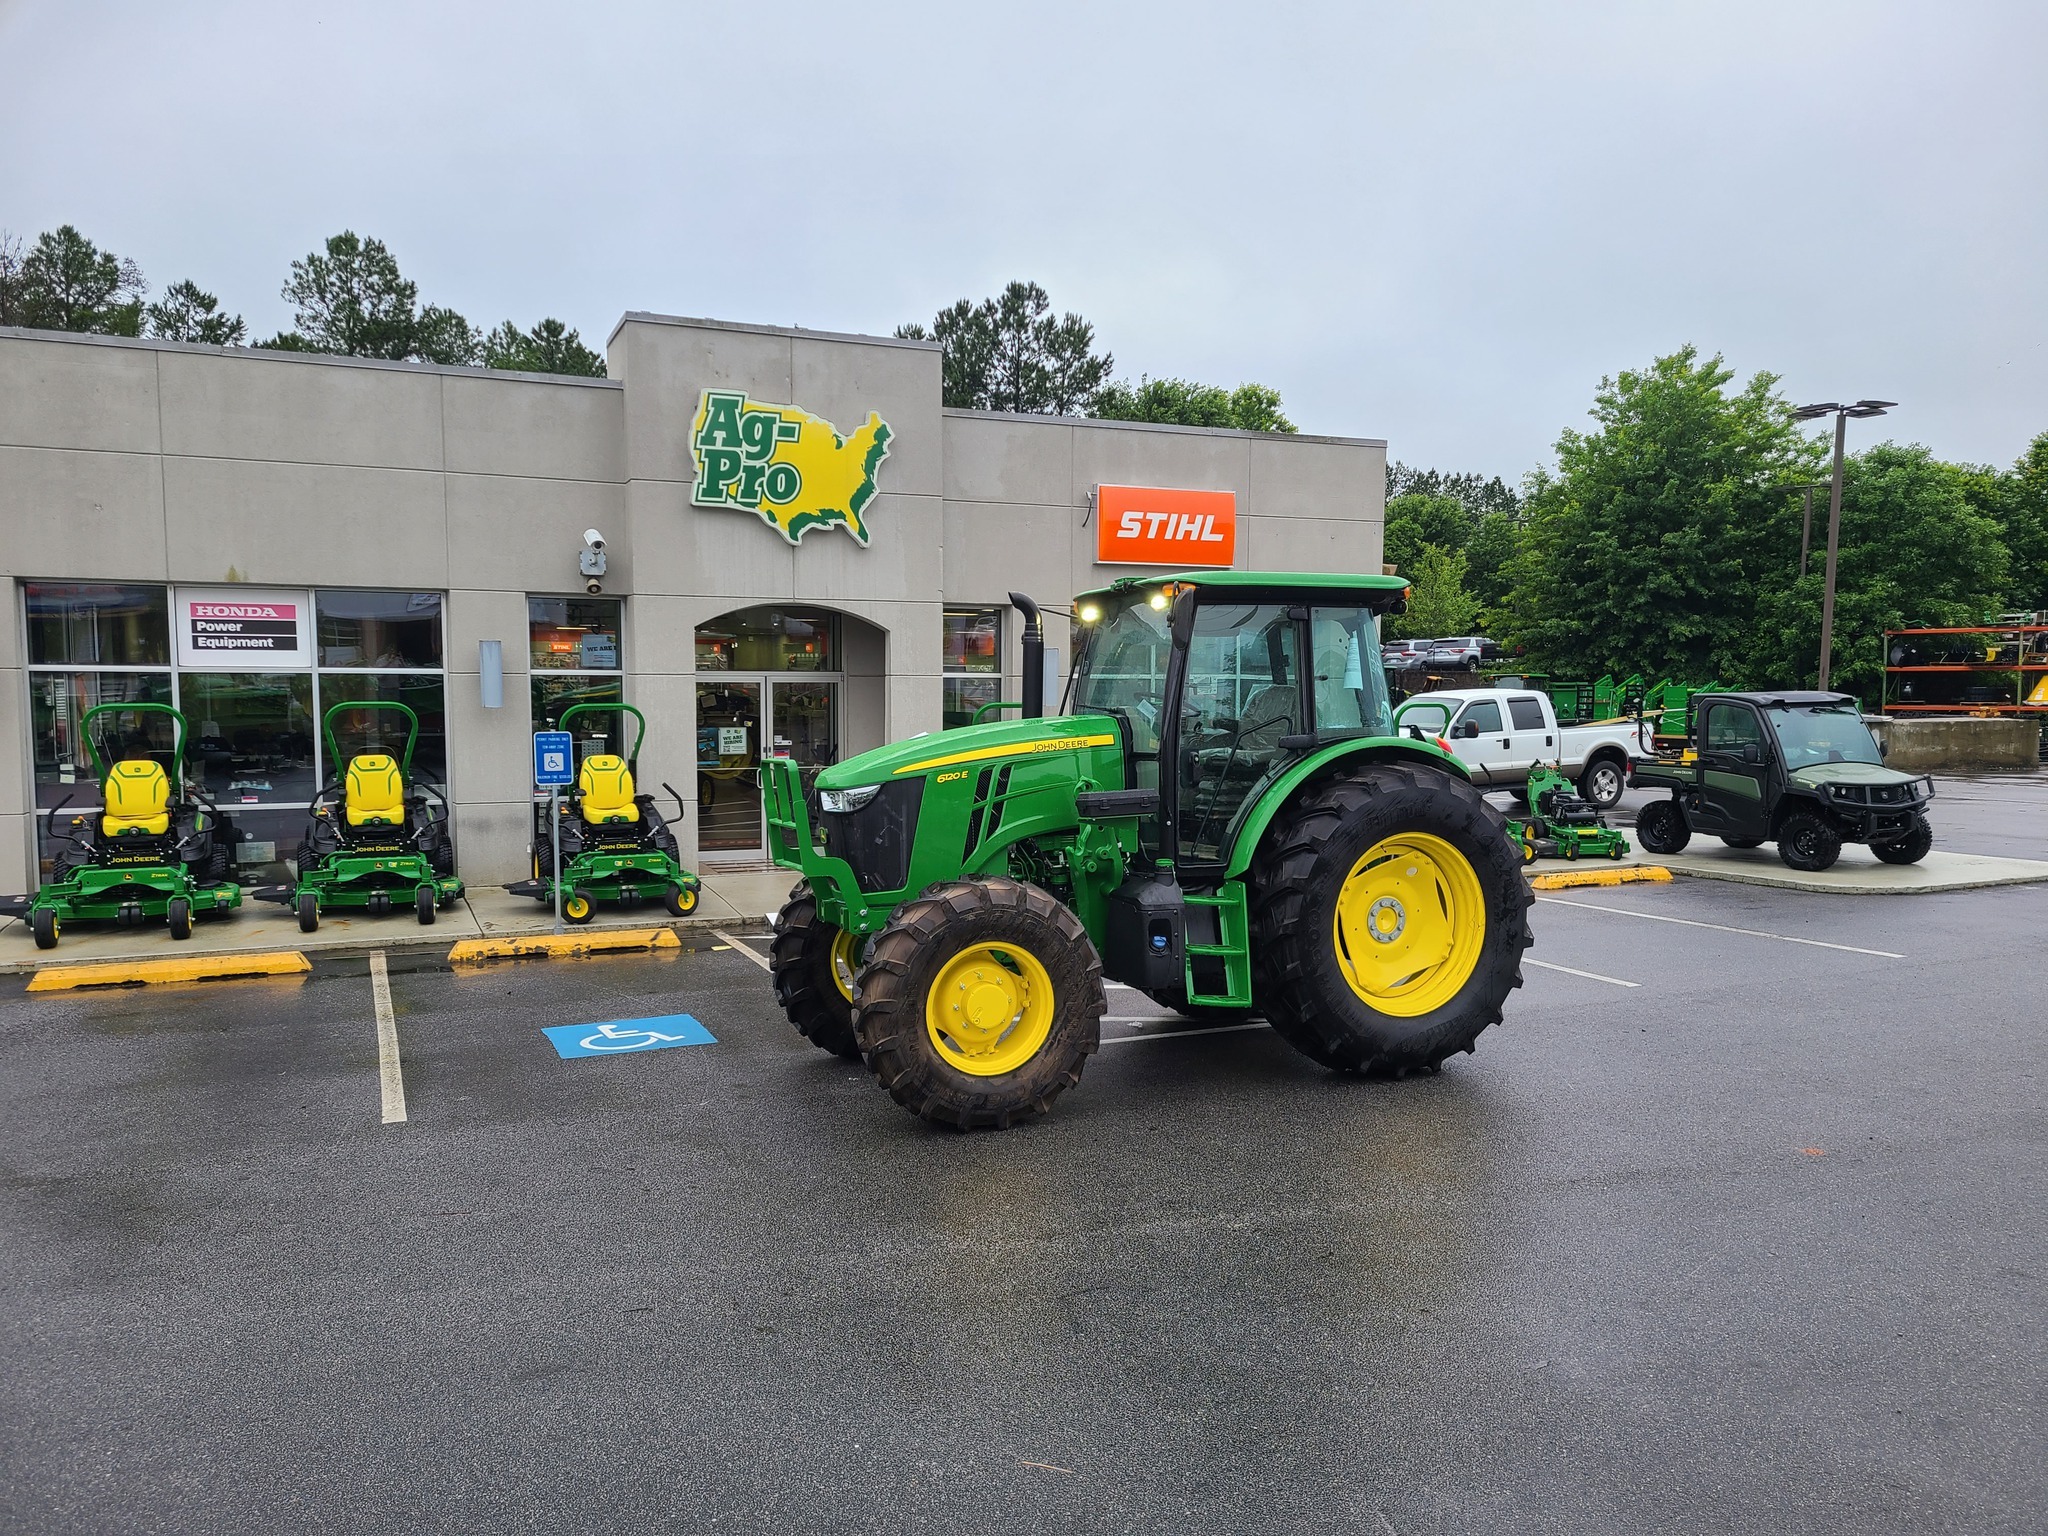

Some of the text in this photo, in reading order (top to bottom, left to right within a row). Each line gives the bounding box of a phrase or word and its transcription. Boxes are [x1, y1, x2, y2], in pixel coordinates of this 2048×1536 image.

[695, 393, 801, 462] Ag-
[697, 448, 802, 504] Pro
[1117, 511, 1224, 541] STIHL
[195, 605, 279, 618] HONDA
[196, 621, 243, 632] Power
[197, 637, 274, 649] Equipment
[1032, 739, 1089, 752] JOHN DEERE
[937, 770, 969, 783] 6120 E
